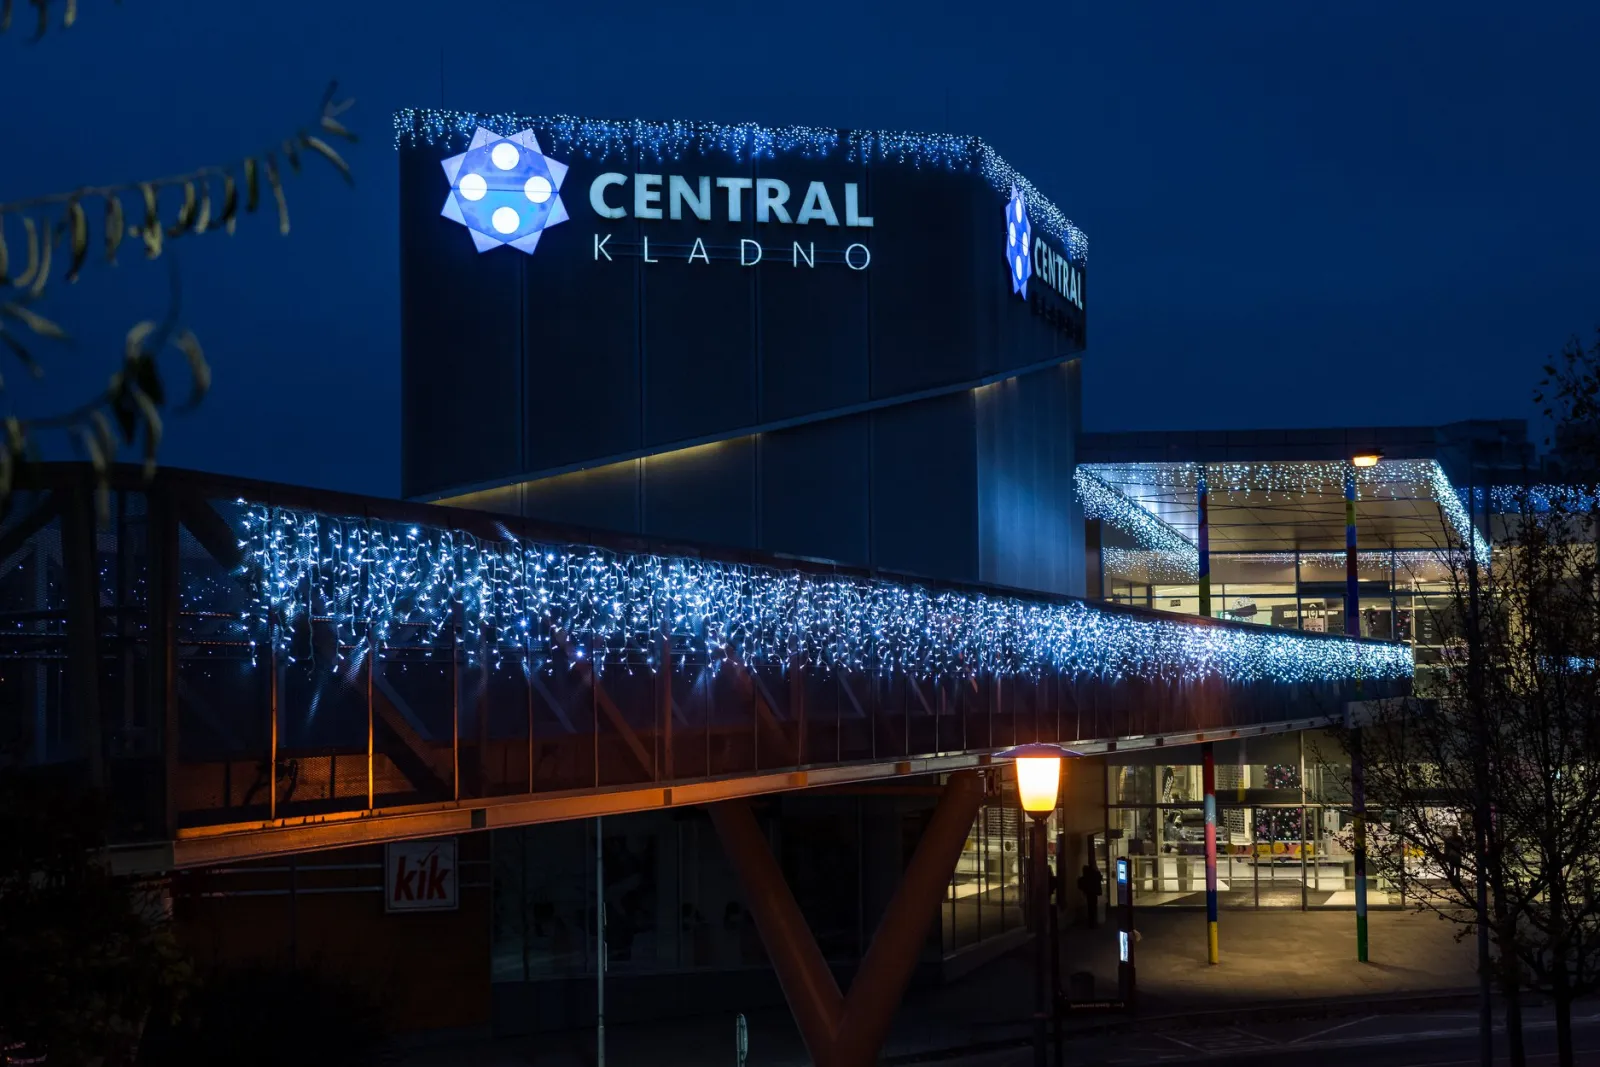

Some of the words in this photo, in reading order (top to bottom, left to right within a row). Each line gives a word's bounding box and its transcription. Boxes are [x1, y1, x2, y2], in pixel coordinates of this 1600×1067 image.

[589, 172, 874, 227] CENTRAL
[594, 233, 871, 270] KLADNO
[1033, 236, 1083, 311] CENTRAL
[394, 844, 451, 901] kik
